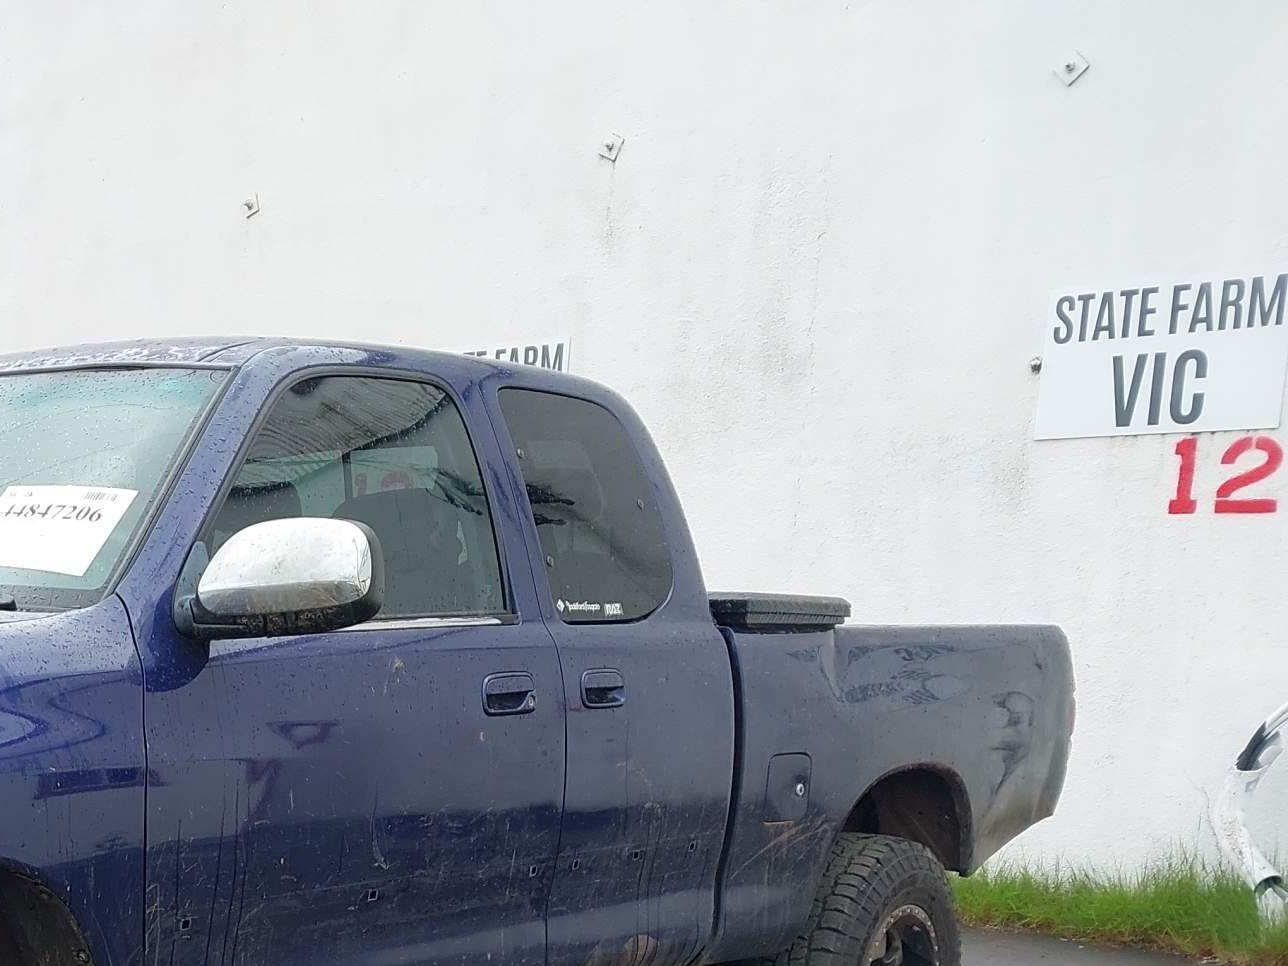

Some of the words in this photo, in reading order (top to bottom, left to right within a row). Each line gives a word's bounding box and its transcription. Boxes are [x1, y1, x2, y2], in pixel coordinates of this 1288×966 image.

[1053, 286, 1160, 345] STATE
[1168, 273, 1288, 335] FARM
[495, 342, 564, 372] RM
[1112, 349, 1208, 428] VIC
[1168, 436, 1285, 515] 12
